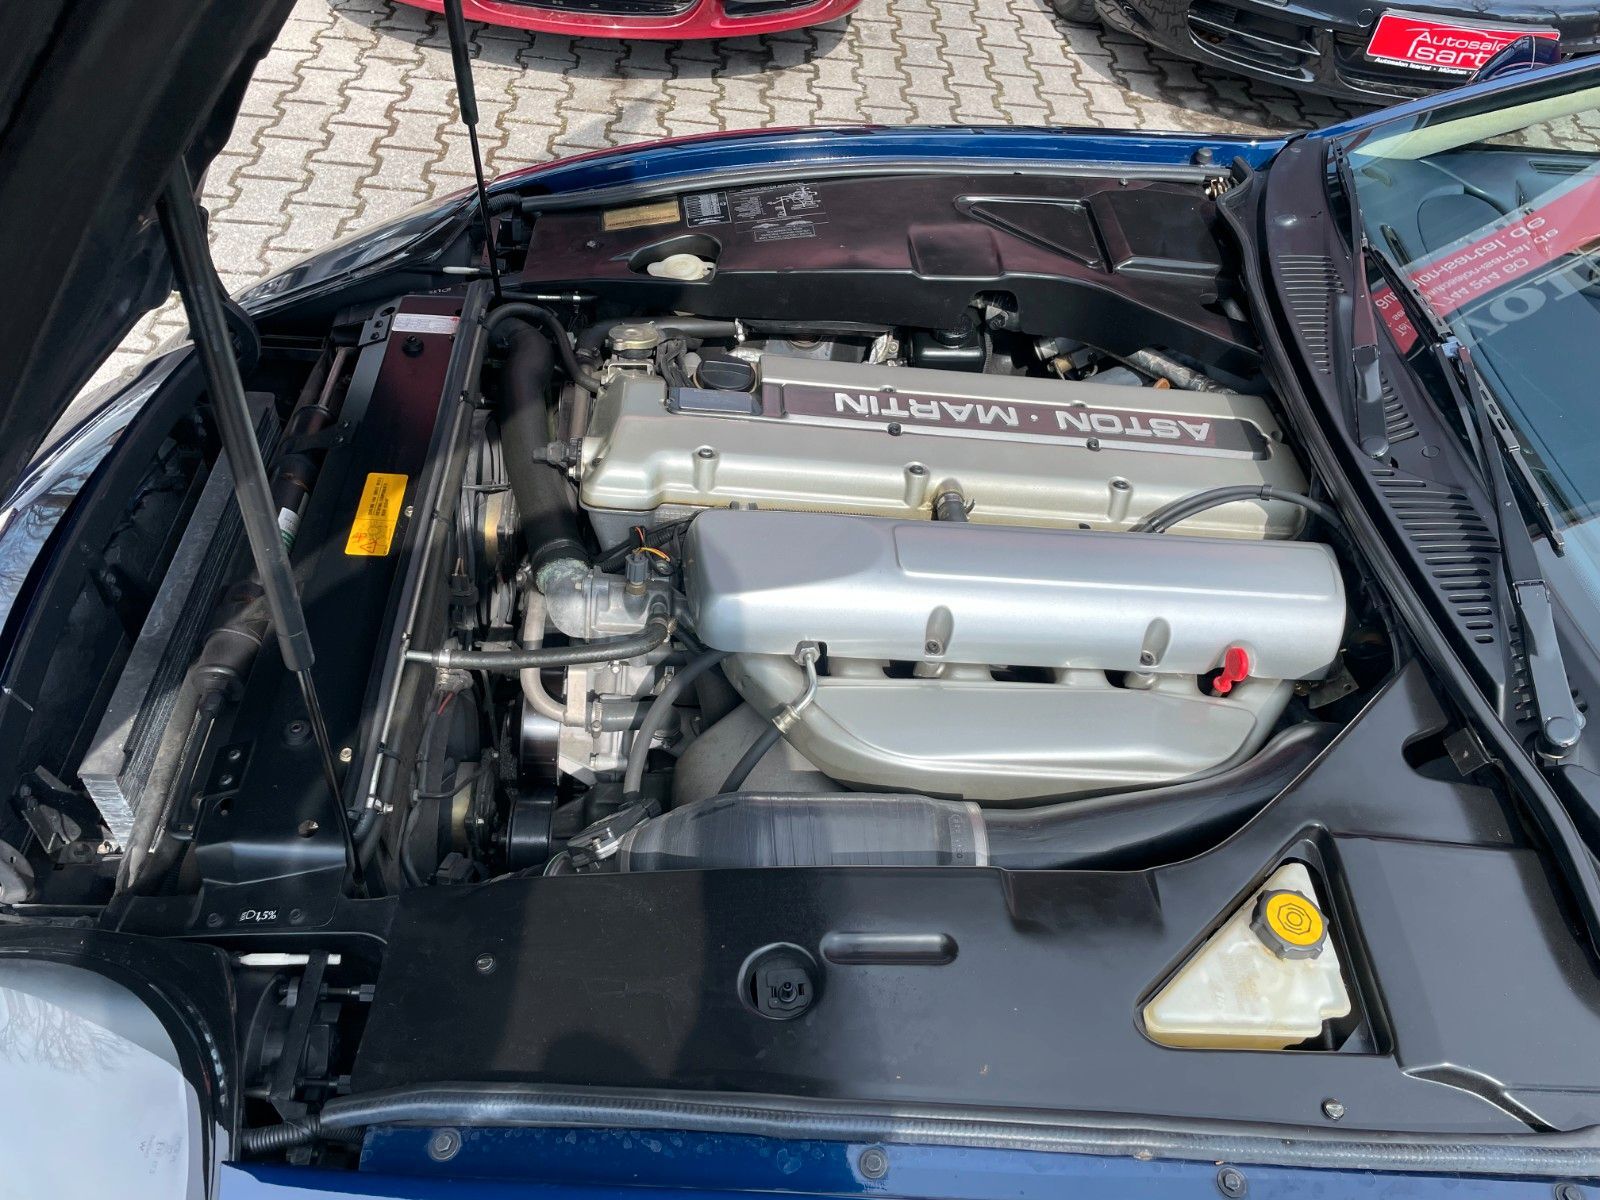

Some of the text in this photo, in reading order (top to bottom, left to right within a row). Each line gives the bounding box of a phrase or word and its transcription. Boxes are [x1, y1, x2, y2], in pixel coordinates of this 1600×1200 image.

[1407, 40, 1491, 67] Isart
[1415, 31, 1506, 53] Autosalo
[834, 392, 1211, 442] ASTON MARTIN
